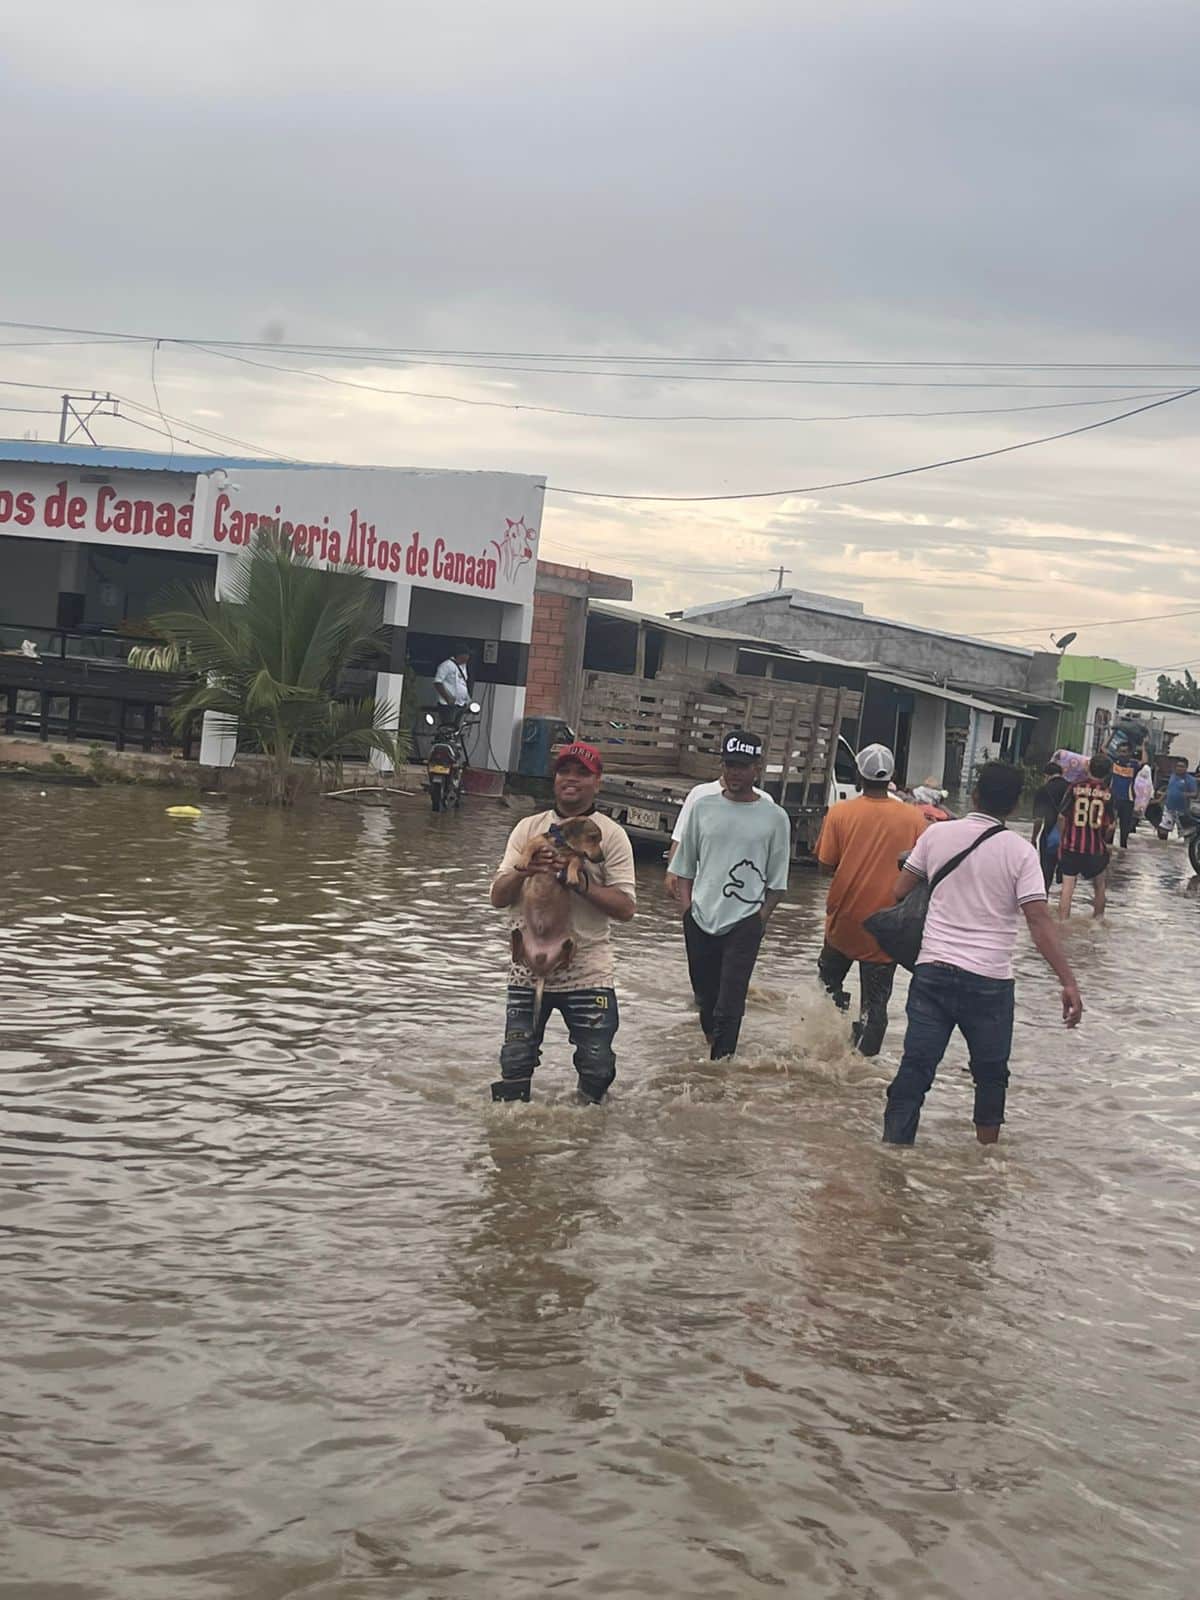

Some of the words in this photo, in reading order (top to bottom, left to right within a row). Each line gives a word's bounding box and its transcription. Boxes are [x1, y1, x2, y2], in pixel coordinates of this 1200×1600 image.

[44, 480, 87, 529] de
[214, 494, 341, 564] Cariceria
[344, 509, 401, 573] Altos
[406, 532, 429, 577] de
[433, 538, 497, 590] Canaán
[1074, 797, 1104, 829] 80
